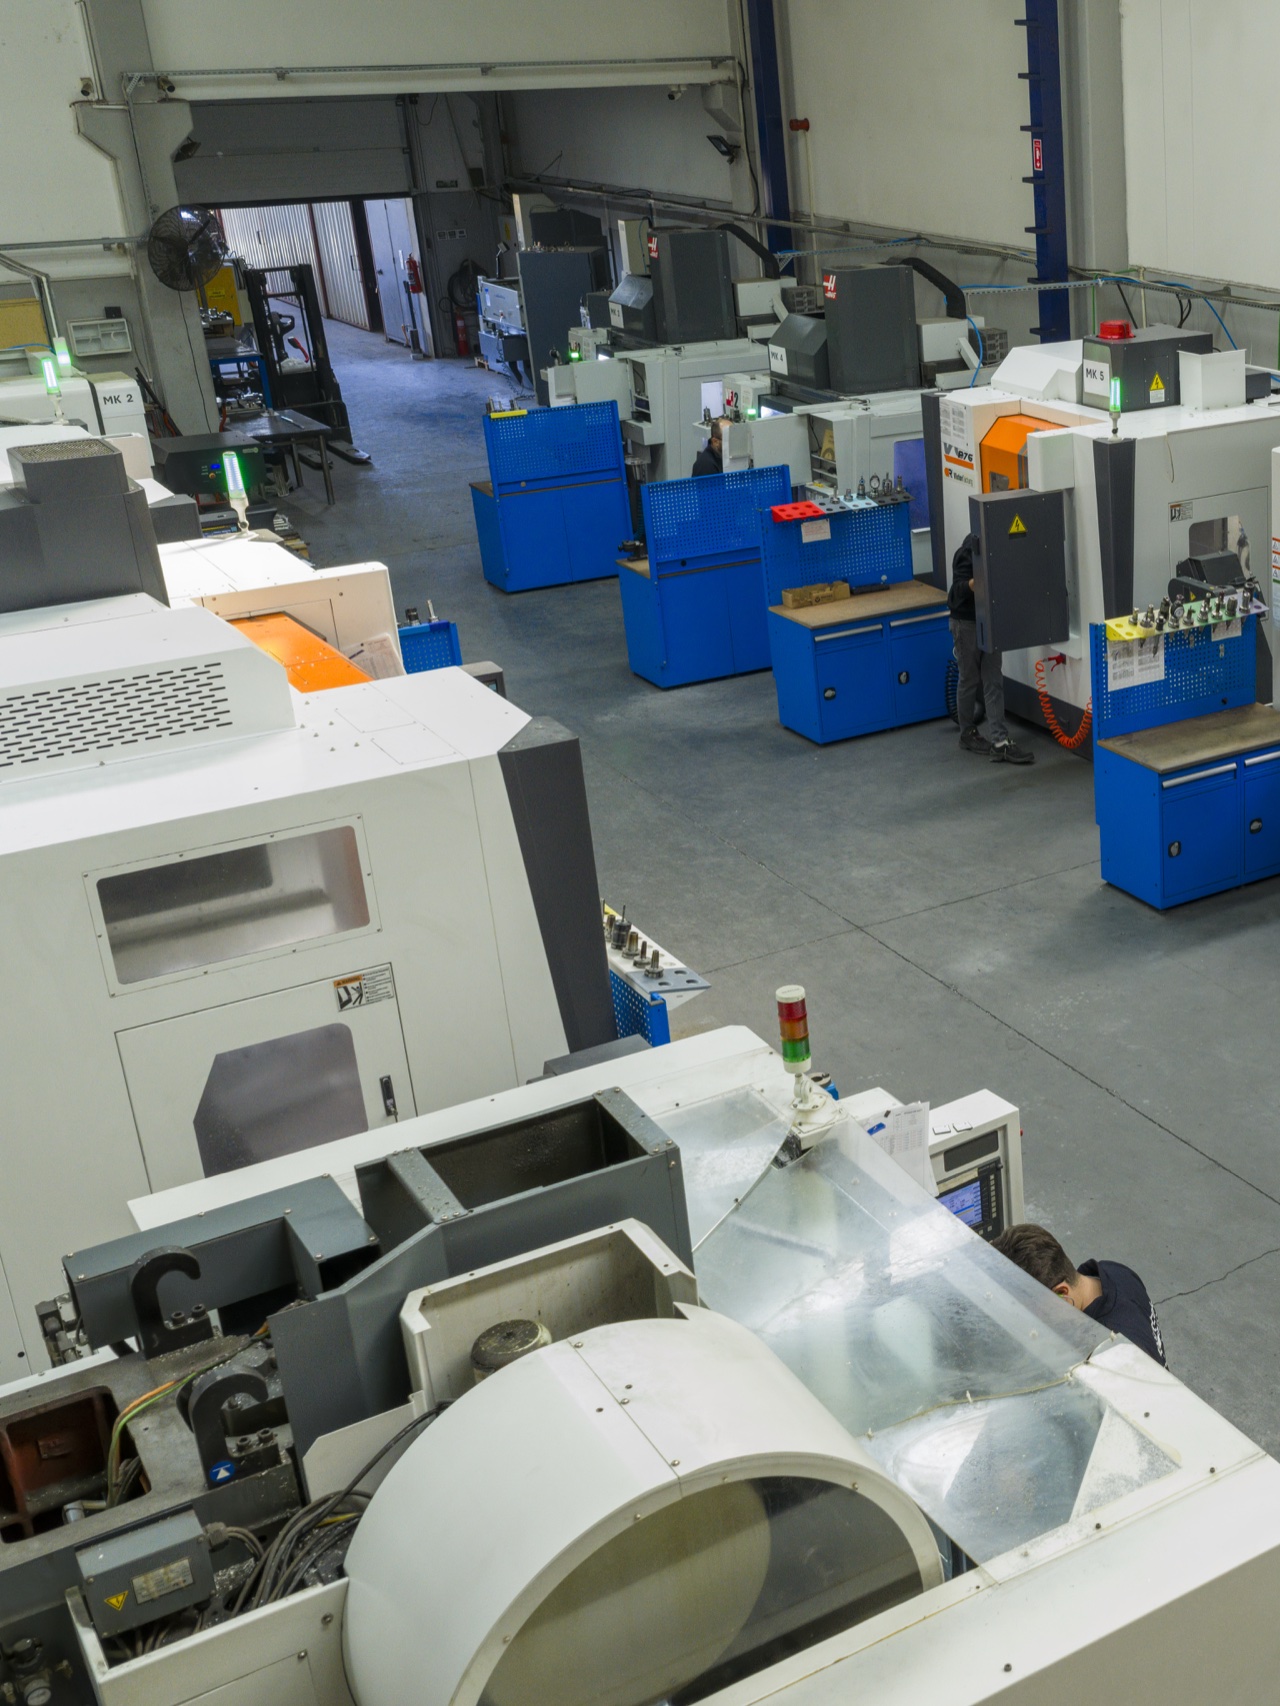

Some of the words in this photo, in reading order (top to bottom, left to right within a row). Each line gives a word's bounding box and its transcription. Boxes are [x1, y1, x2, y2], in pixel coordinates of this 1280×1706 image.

[771, 351, 779, 361] MK
[780, 354, 784, 362] 4
[1086, 368, 1097, 380] MK
[1099, 371, 1105, 381] 5
[103, 395, 121, 405] MK
[126, 393, 134, 403] 2
